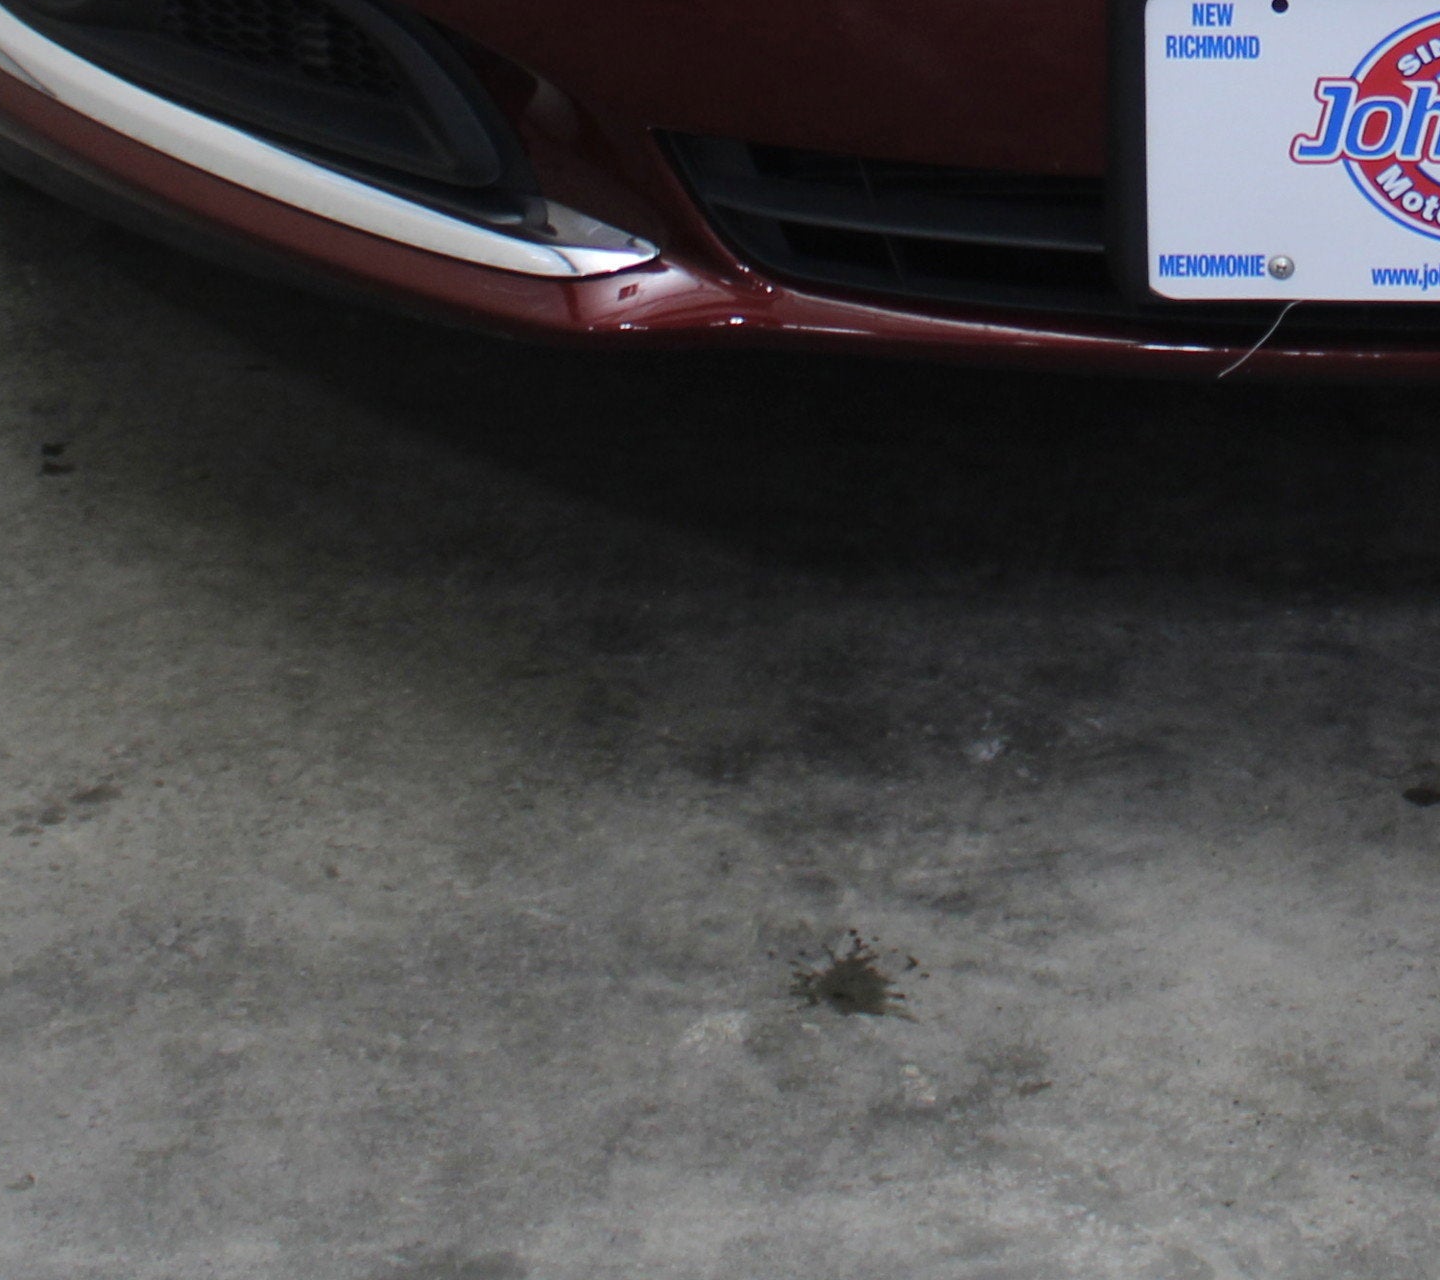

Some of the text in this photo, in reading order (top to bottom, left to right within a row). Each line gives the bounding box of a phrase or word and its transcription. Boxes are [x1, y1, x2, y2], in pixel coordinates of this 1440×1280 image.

[1191, 3, 1234, 27] NEW
[1165, 36, 1260, 60] RICHMOND
[1159, 255, 1266, 278] MENOMONIE
